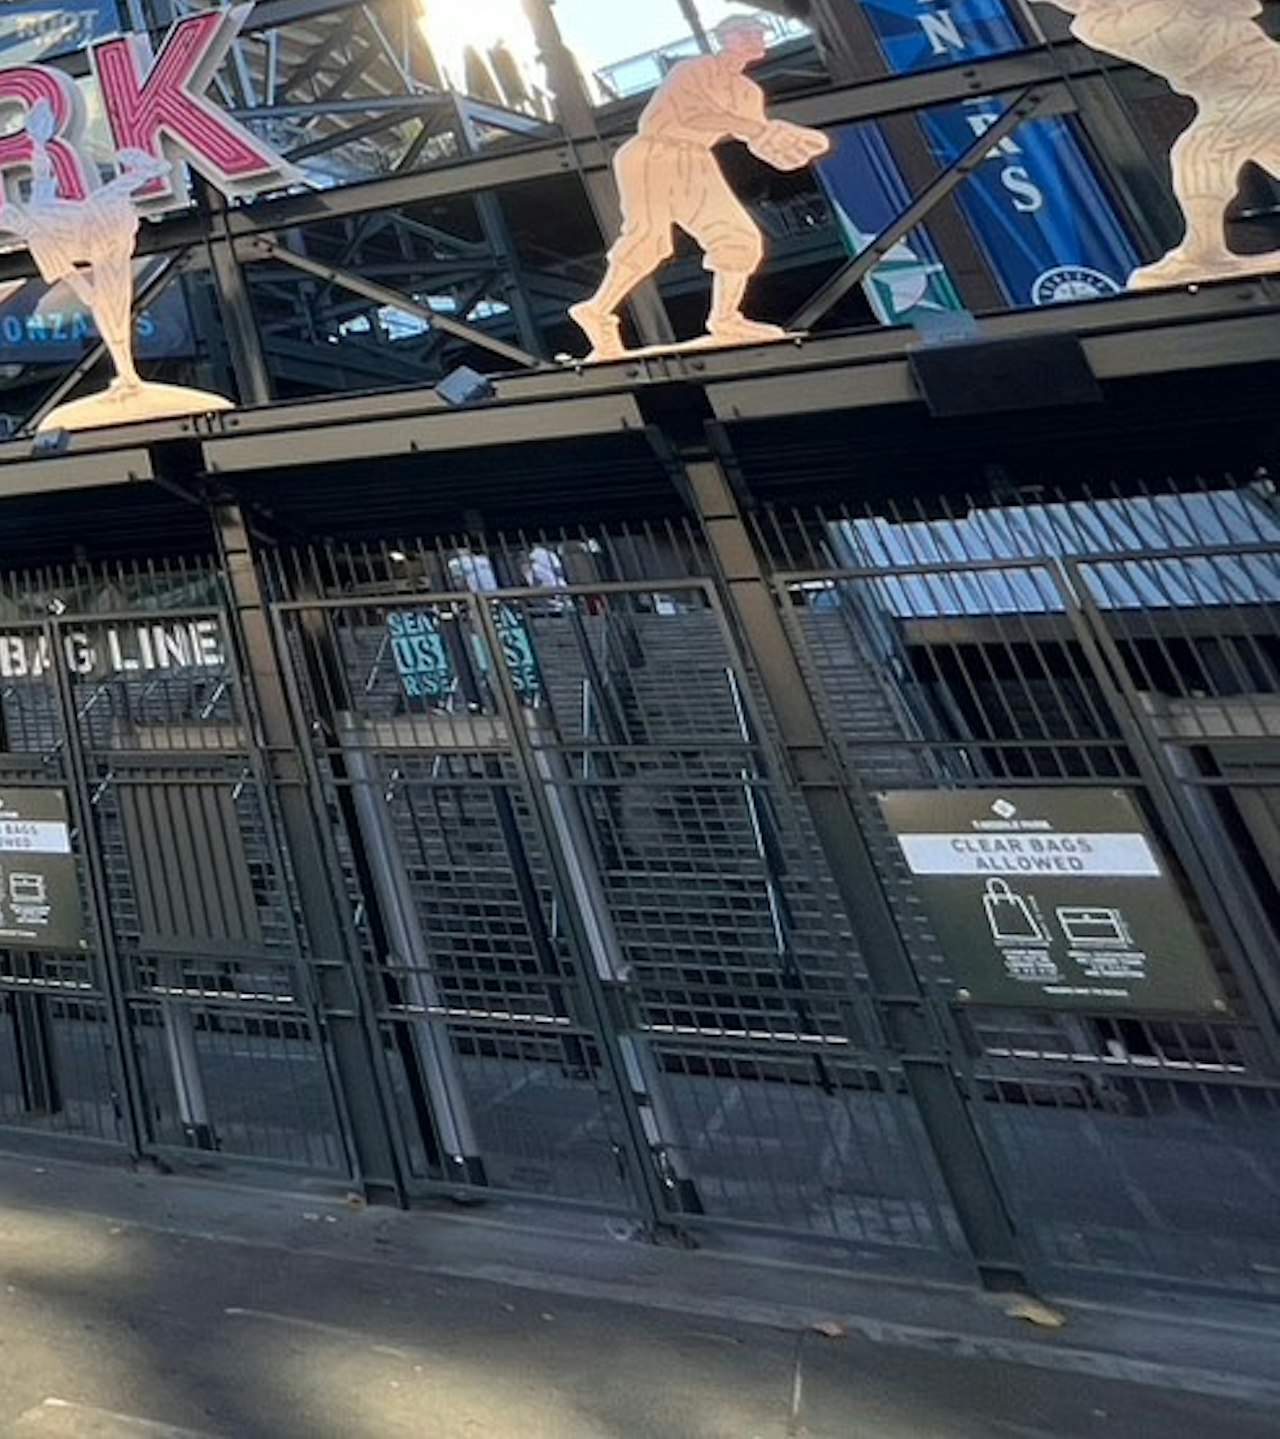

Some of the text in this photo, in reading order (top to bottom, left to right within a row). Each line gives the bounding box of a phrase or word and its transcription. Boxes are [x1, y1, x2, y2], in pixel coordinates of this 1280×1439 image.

[107, 619, 225, 672] LINE
[5, 824, 38, 836] BAGS
[950, 837, 1094, 853] CLEAR BAGS
[976, 856, 1084, 871] ALLOWED
